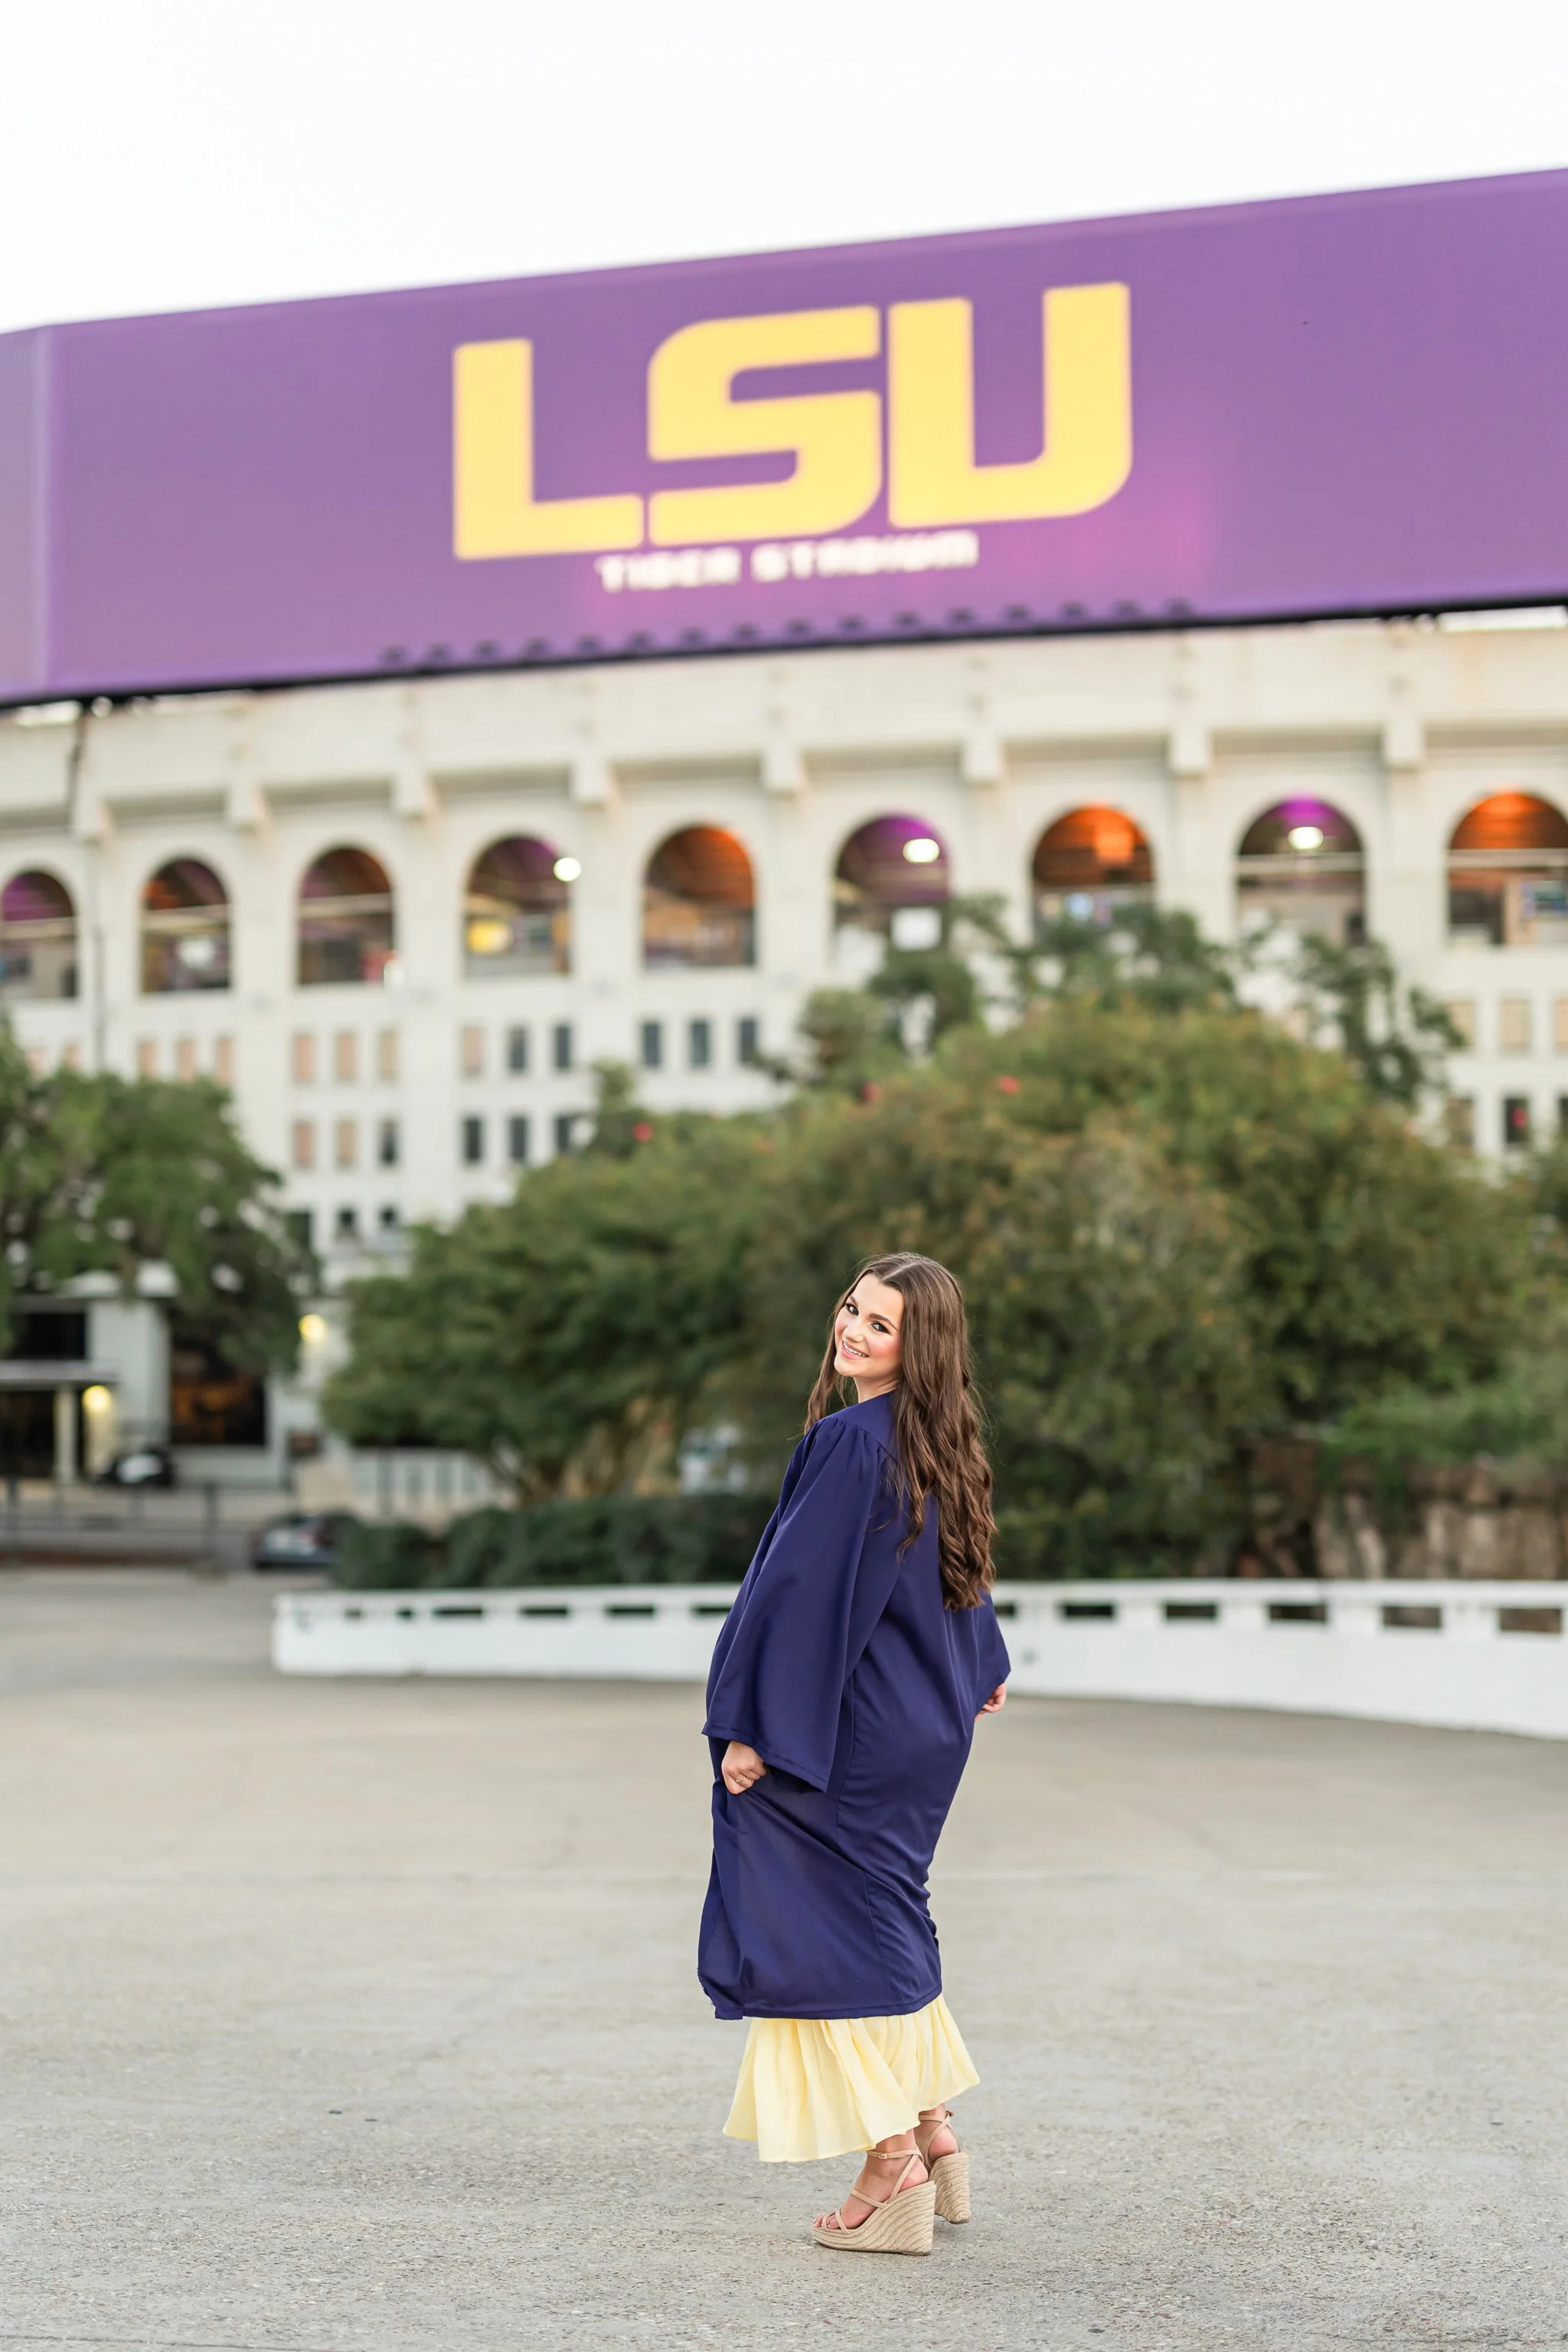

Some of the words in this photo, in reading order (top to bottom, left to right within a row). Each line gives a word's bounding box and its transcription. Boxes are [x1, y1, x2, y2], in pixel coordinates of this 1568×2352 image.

[454, 282, 1132, 560] LSU
[596, 547, 741, 592] TIGER
[752, 530, 978, 582] STADIUM
